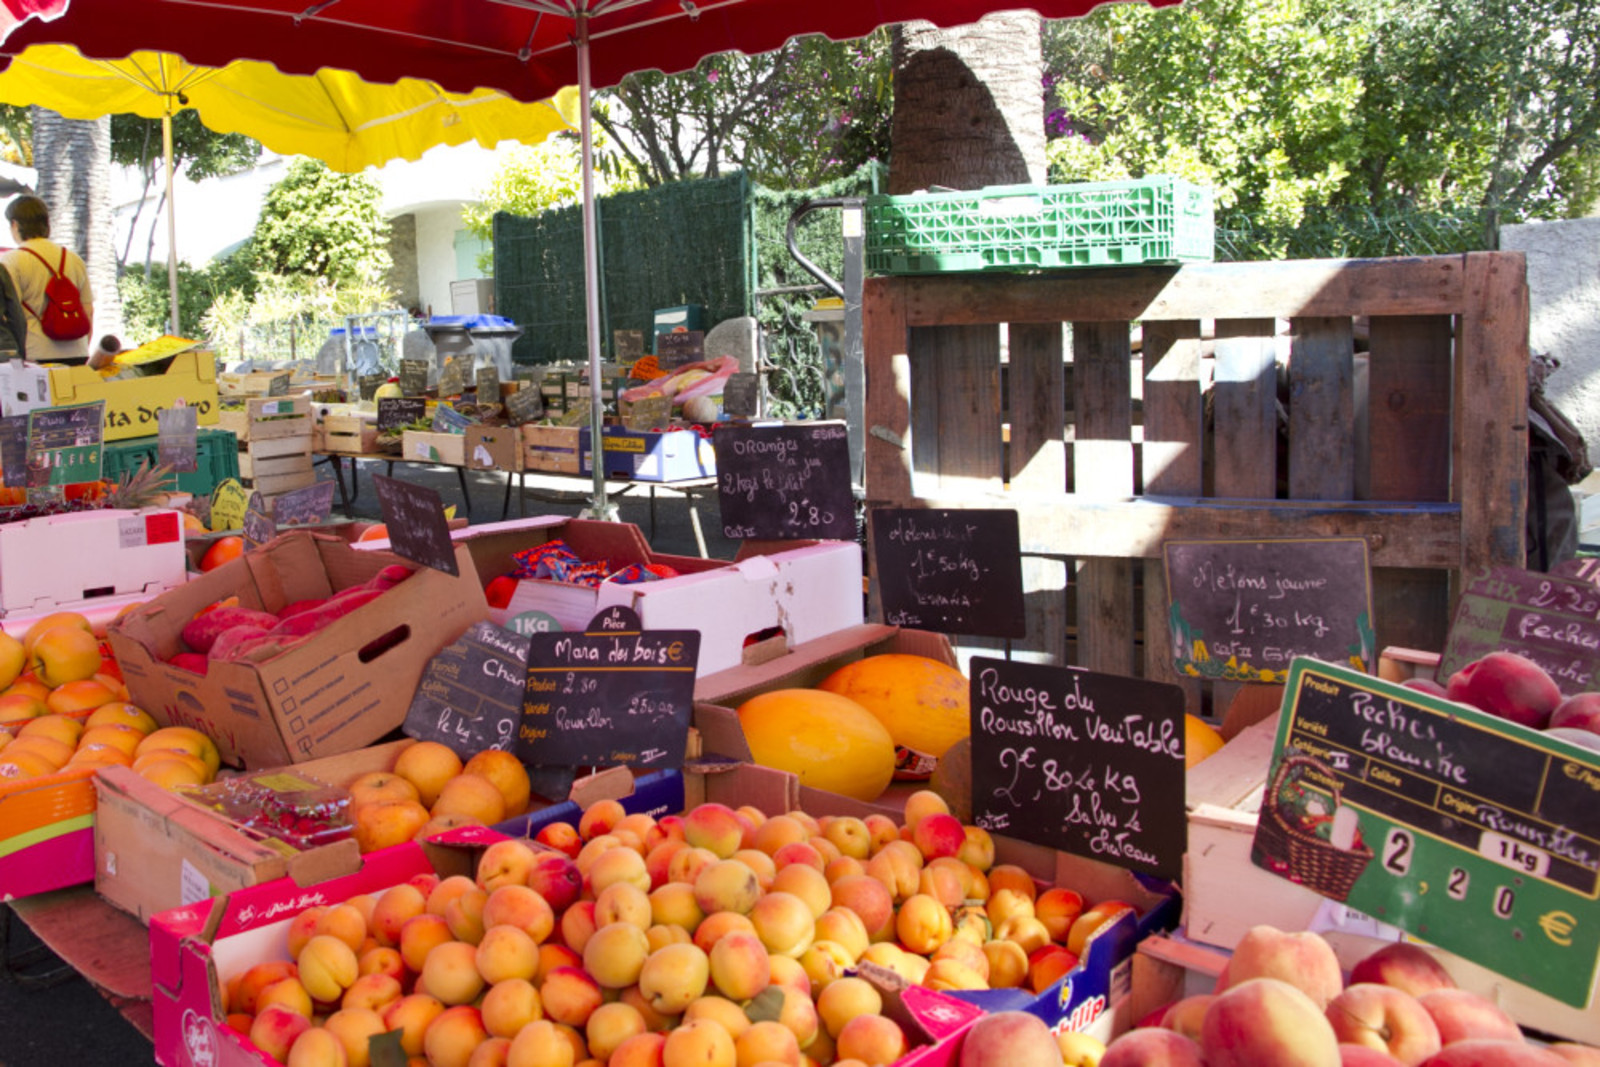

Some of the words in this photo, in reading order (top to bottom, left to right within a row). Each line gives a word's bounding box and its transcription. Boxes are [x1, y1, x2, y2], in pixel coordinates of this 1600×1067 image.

[632, 636, 667, 664] bois
[979, 667, 1056, 714] Rouge
[1304, 675, 1340, 697] Produit
